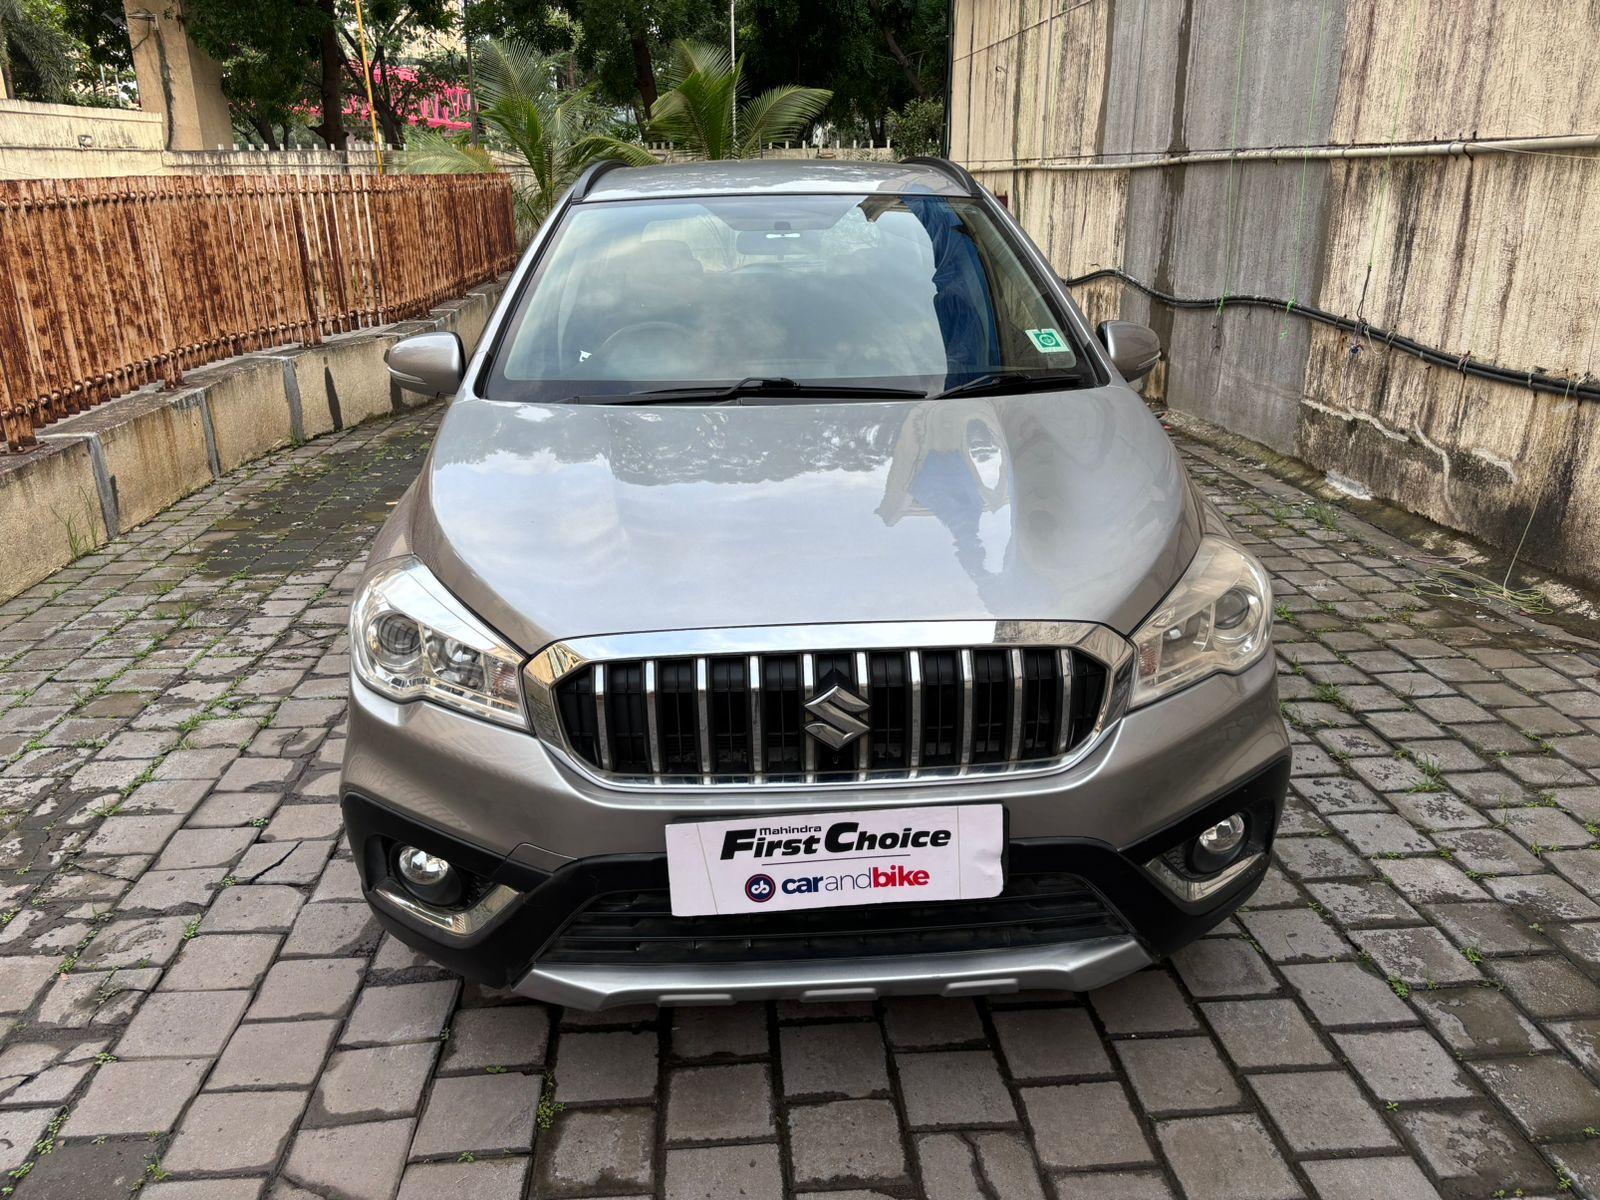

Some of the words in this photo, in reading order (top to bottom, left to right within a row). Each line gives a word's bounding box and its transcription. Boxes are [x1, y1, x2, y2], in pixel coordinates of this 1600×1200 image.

[720, 829, 821, 860] First
[824, 822, 951, 853] Choice
[781, 865, 930, 894] carandbike
